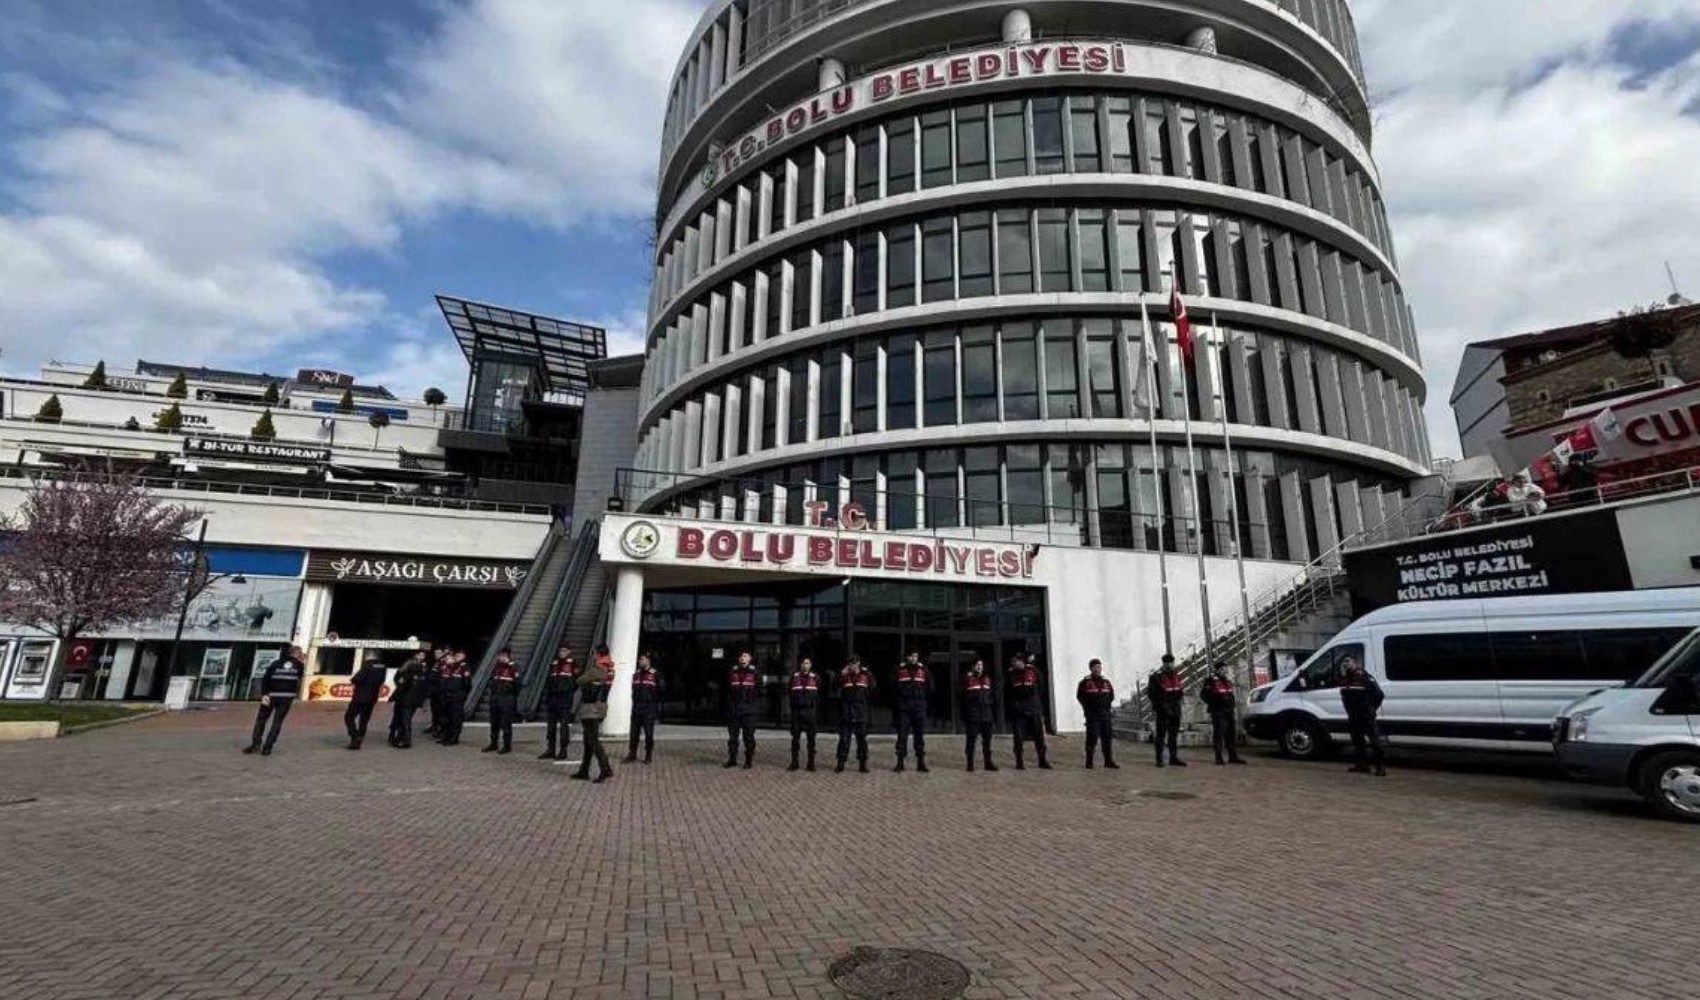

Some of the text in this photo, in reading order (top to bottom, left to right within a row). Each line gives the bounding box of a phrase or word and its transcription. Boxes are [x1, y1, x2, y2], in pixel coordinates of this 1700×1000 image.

[872, 43, 1126, 100] BELEDİYESİ
[1626, 404, 1700, 446] CU
[248, 444, 326, 461] RESTAURANT
[676, 527, 1034, 578] BOLU BELEDİYESİ
[1419, 549, 1451, 562] BOLU
[1454, 535, 1533, 558] BELEDİYESİ
[433, 563, 499, 584] ÇARŞI
[1400, 555, 1531, 584] NECİP FAZIL
[1397, 570, 1548, 601] KÜLTÜR MERKEZİ
